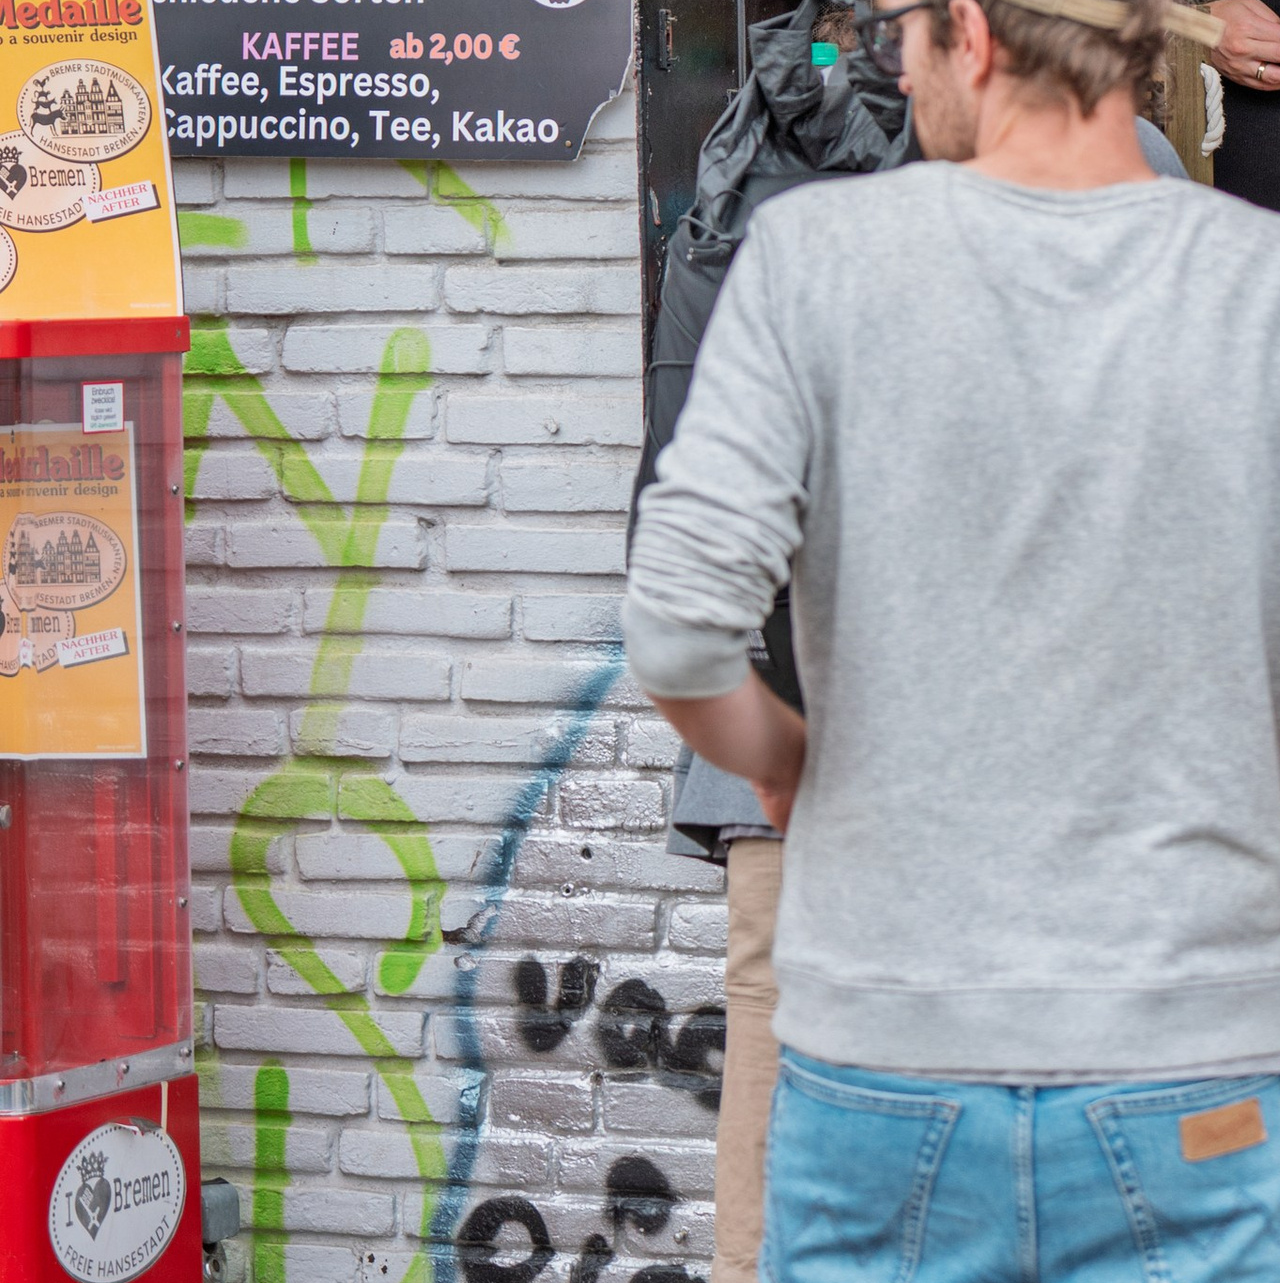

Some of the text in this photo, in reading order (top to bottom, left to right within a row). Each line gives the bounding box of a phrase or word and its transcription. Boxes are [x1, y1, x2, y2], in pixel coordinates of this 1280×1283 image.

[23, 29, 137, 45] souvenir design
[243, 33, 492, 65] KAFFEE 2,00
[49, 63, 146, 124] BREMER STADTMUSIKANTEN
[280, 66, 439, 104] Espresso,
[39, 129, 139, 157] HANSESTADT BREMEN
[369, 111, 440, 148] Tee,
[453, 110, 558, 143] Kakao
[29, 166, 85, 187] Bremen
[88, 184, 147, 204] NACHHER
[101, 197, 139, 213] AFTER
[65, 1168, 170, 1227] I Bremen
[64, 1216, 170, 1278] FREIE HANSESTADT
